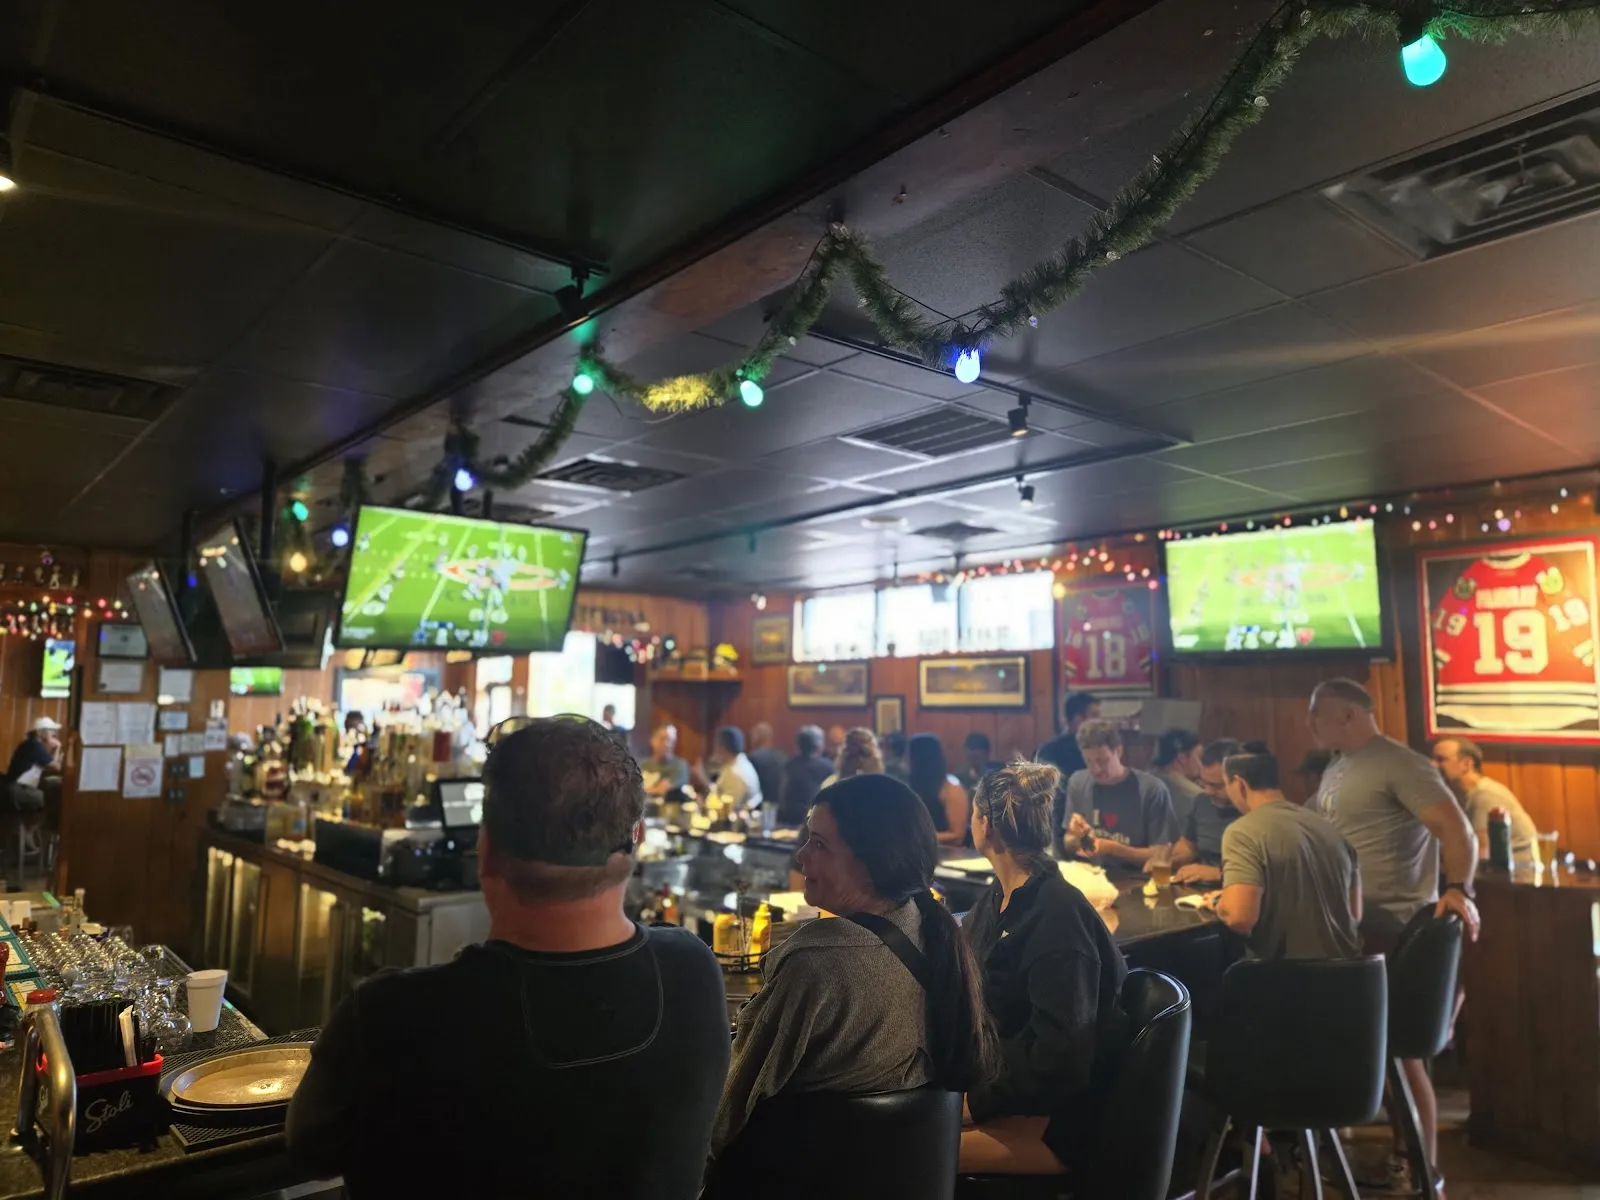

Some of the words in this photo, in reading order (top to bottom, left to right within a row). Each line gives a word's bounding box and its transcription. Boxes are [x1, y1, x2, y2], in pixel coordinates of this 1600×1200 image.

[1433, 608, 1467, 636] 19
[1548, 597, 1589, 632] 19
[1087, 634, 1126, 678] 18
[1473, 609, 1549, 675] 19
[85, 1090, 134, 1133] Stoli
